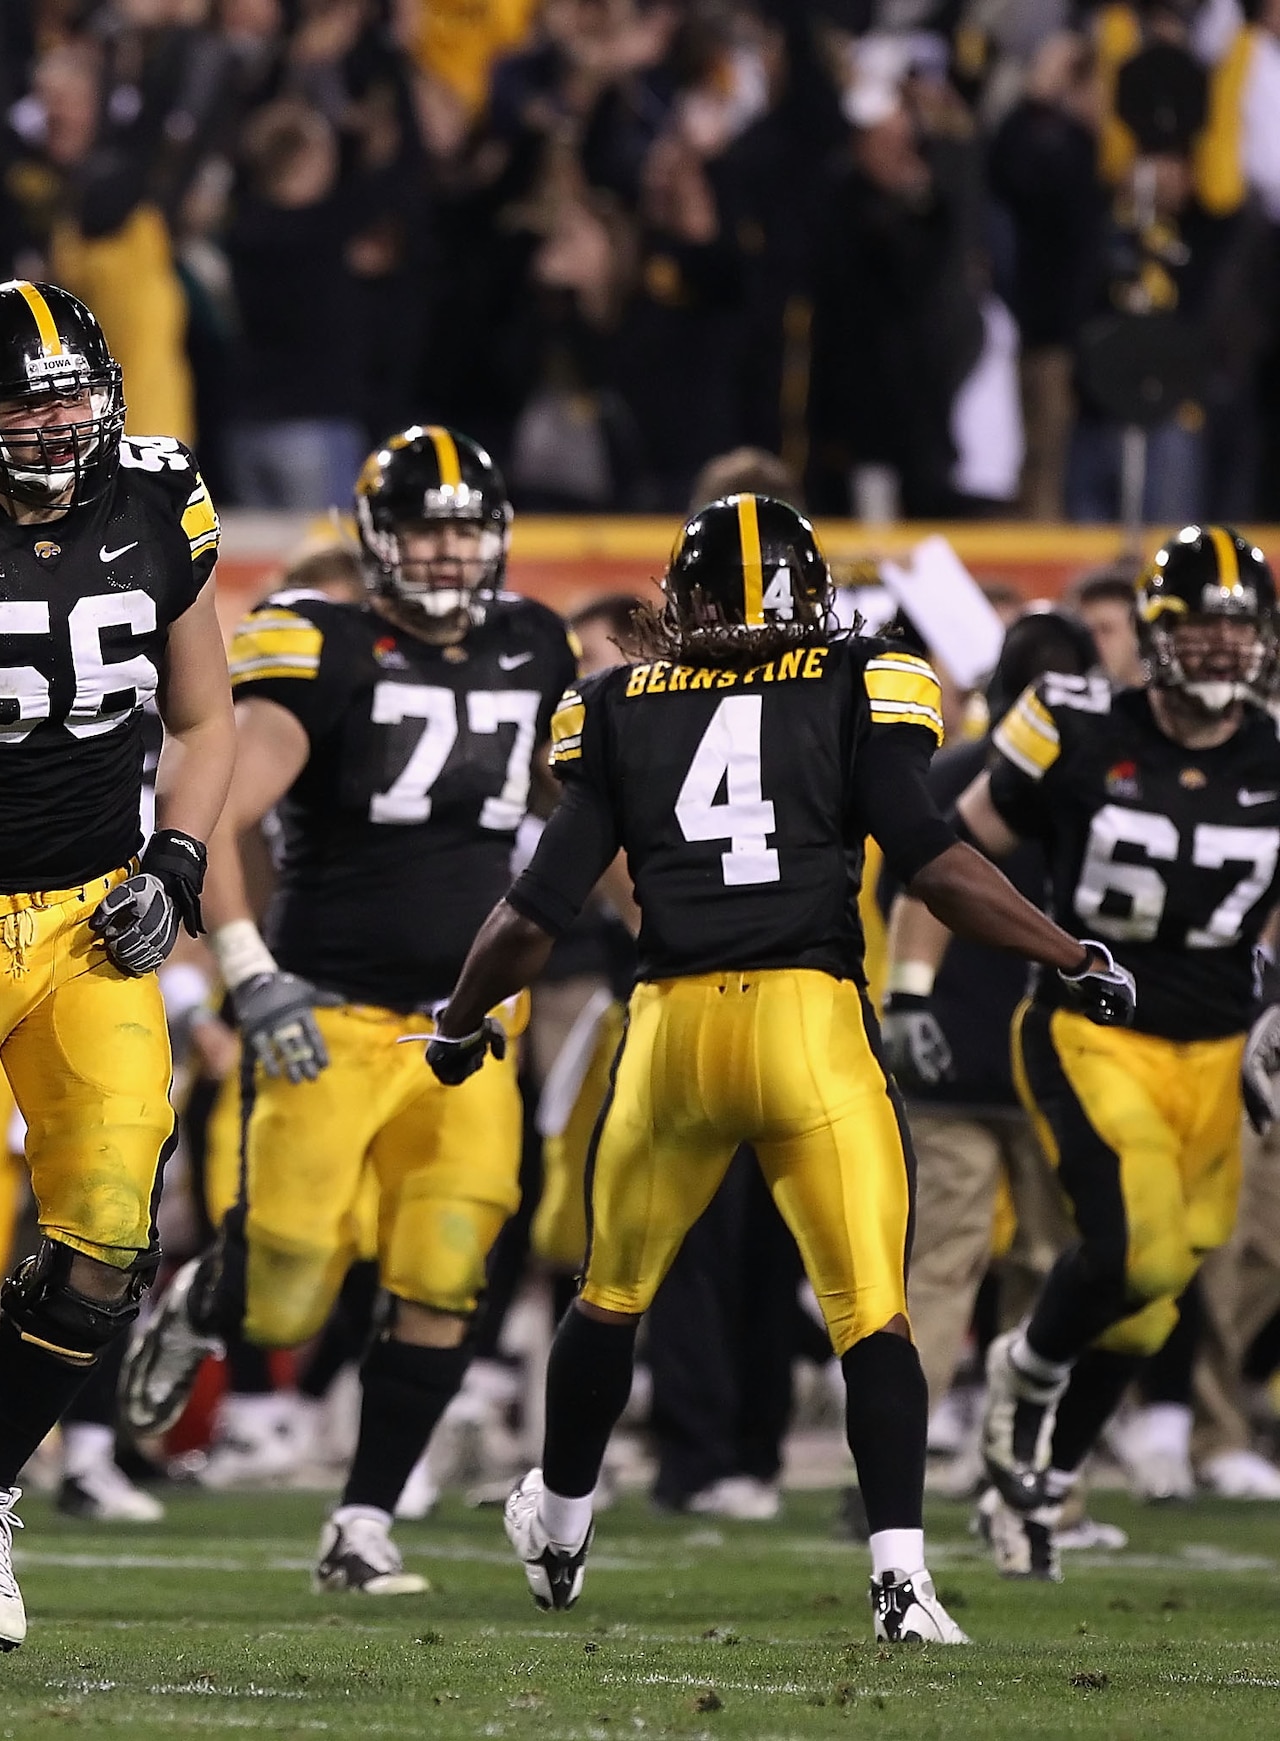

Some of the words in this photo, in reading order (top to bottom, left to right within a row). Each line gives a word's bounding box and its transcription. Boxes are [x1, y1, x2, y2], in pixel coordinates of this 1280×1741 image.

[43, 358, 71, 370] IOWA
[763, 567, 794, 621] 4
[369, 680, 542, 830] 77
[675, 694, 781, 886] 4
[1073, 803, 1280, 948] 67
